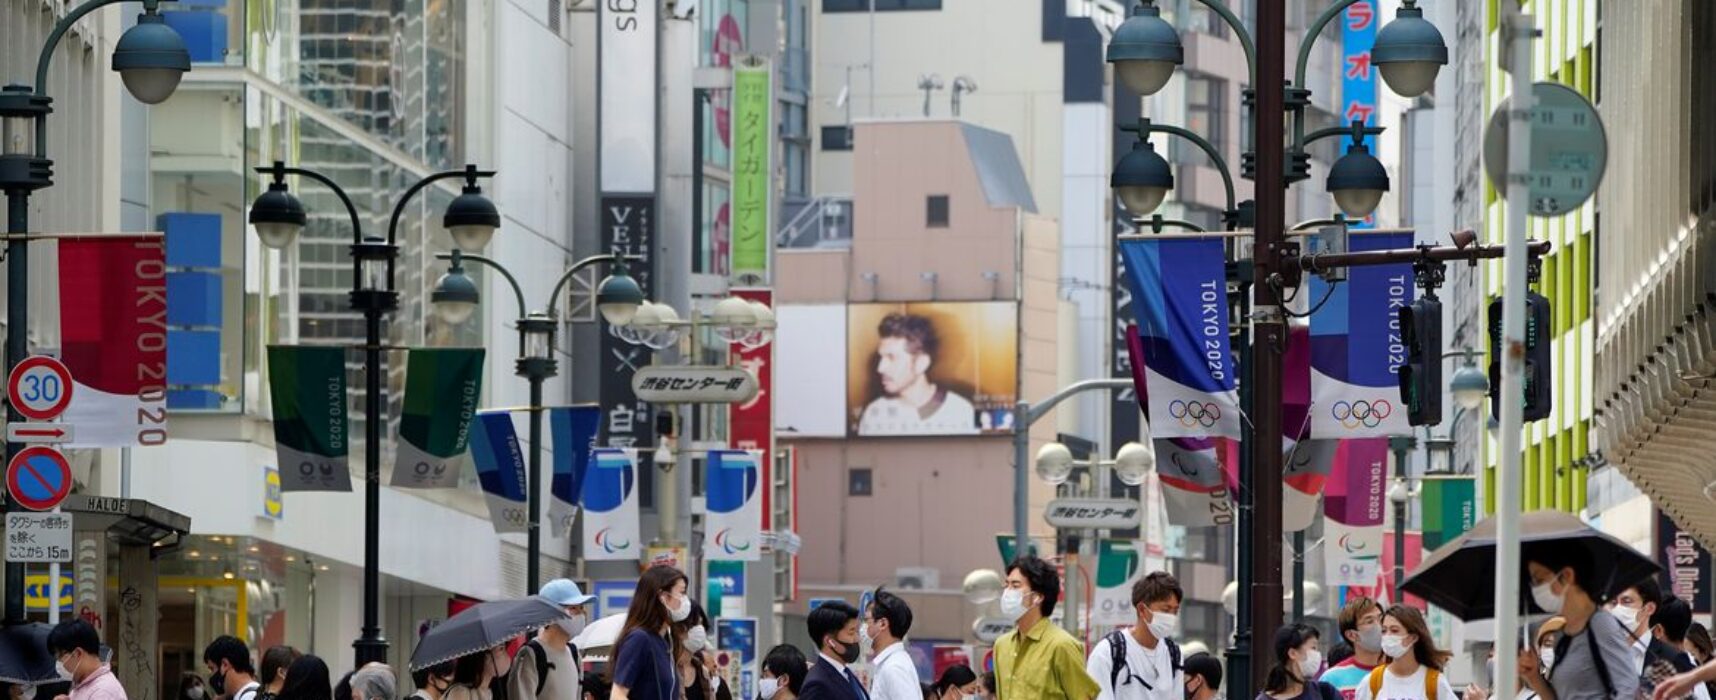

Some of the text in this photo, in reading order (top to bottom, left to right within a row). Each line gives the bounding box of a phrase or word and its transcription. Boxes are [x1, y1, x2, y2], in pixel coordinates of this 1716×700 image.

[740, 111, 761, 243] タイガーデン
[135, 235, 167, 446] TOKYO 2020
[1201, 280, 1224, 379] TOKYO 2020
[24, 375, 59, 402] 30
[640, 376, 745, 391] 渋谷センター街
[328, 377, 342, 449] TOKYO 2020
[456, 380, 476, 449] TOKYO 2020
[506, 435, 522, 468] TOKYO
[1369, 461, 1381, 519] TOKYO 2020
[1051, 507, 1138, 518] 渋谷センター街
[10, 531, 36, 543] を除く
[10, 545, 70, 559] ここから 15m
[1675, 531, 1700, 564] Lad's
